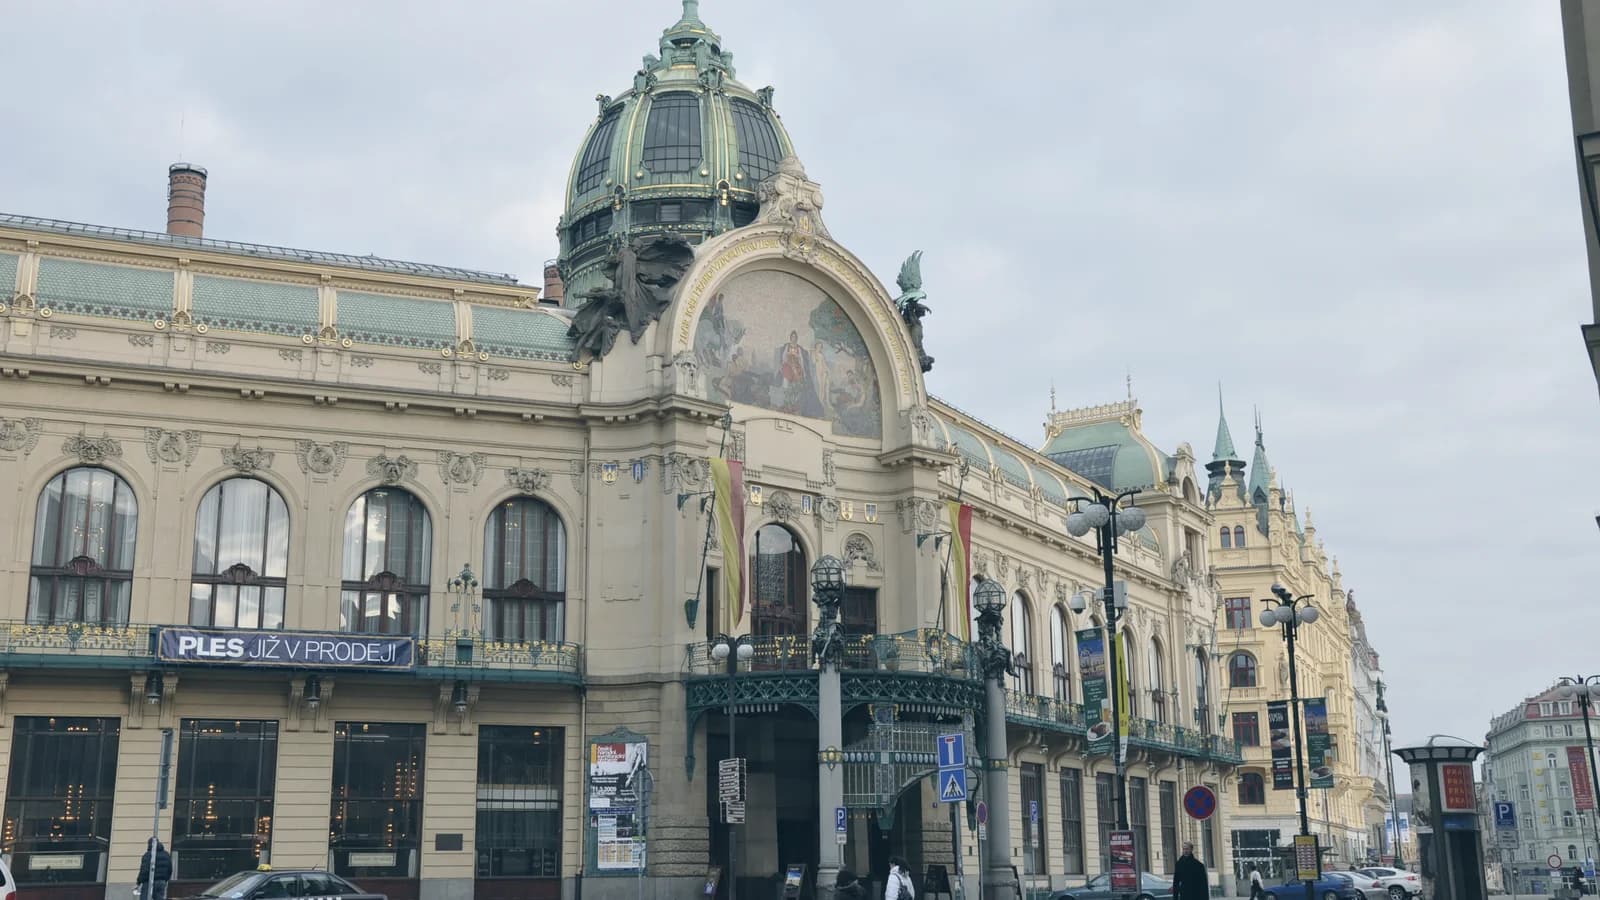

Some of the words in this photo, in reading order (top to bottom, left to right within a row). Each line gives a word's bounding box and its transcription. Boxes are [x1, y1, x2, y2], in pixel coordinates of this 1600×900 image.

[179, 636, 244, 658] PLES
[250, 635, 280, 659] JIŽ
[284, 640, 301, 658] V
[305, 641, 396, 662] PRODEJI
[837, 810, 844, 825] P
[1499, 804, 1510, 819] P
